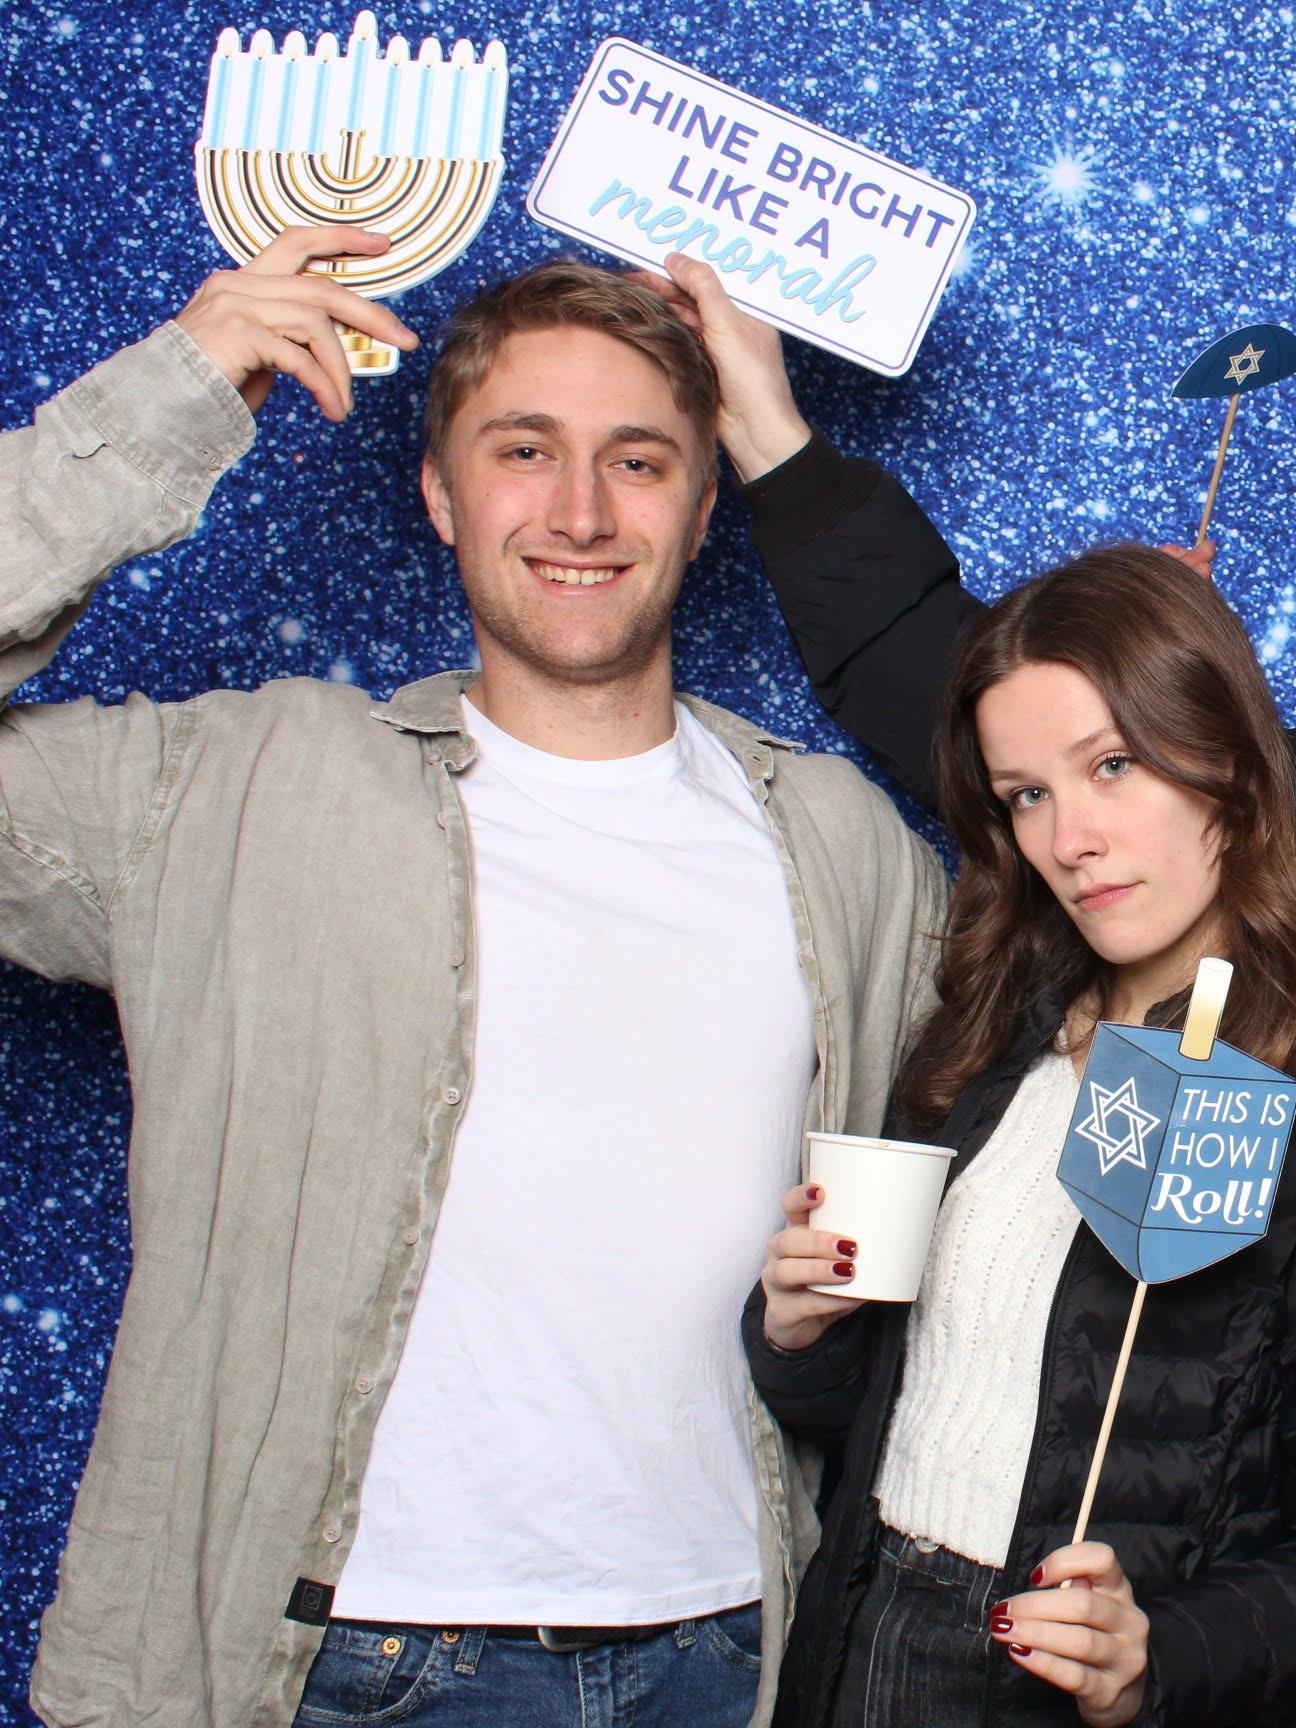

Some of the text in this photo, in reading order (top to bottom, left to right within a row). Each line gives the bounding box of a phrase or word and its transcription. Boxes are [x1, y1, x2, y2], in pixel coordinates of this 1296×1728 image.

[598, 69, 956, 249] SHINE BRIGHT
[667, 155, 831, 259] LIKE A
[588, 178, 878, 324] menorah
[1181, 1088, 1290, 1126] THIS IS
[1170, 1131, 1279, 1171] HOW I
[1150, 1172, 1273, 1226] Roll!
